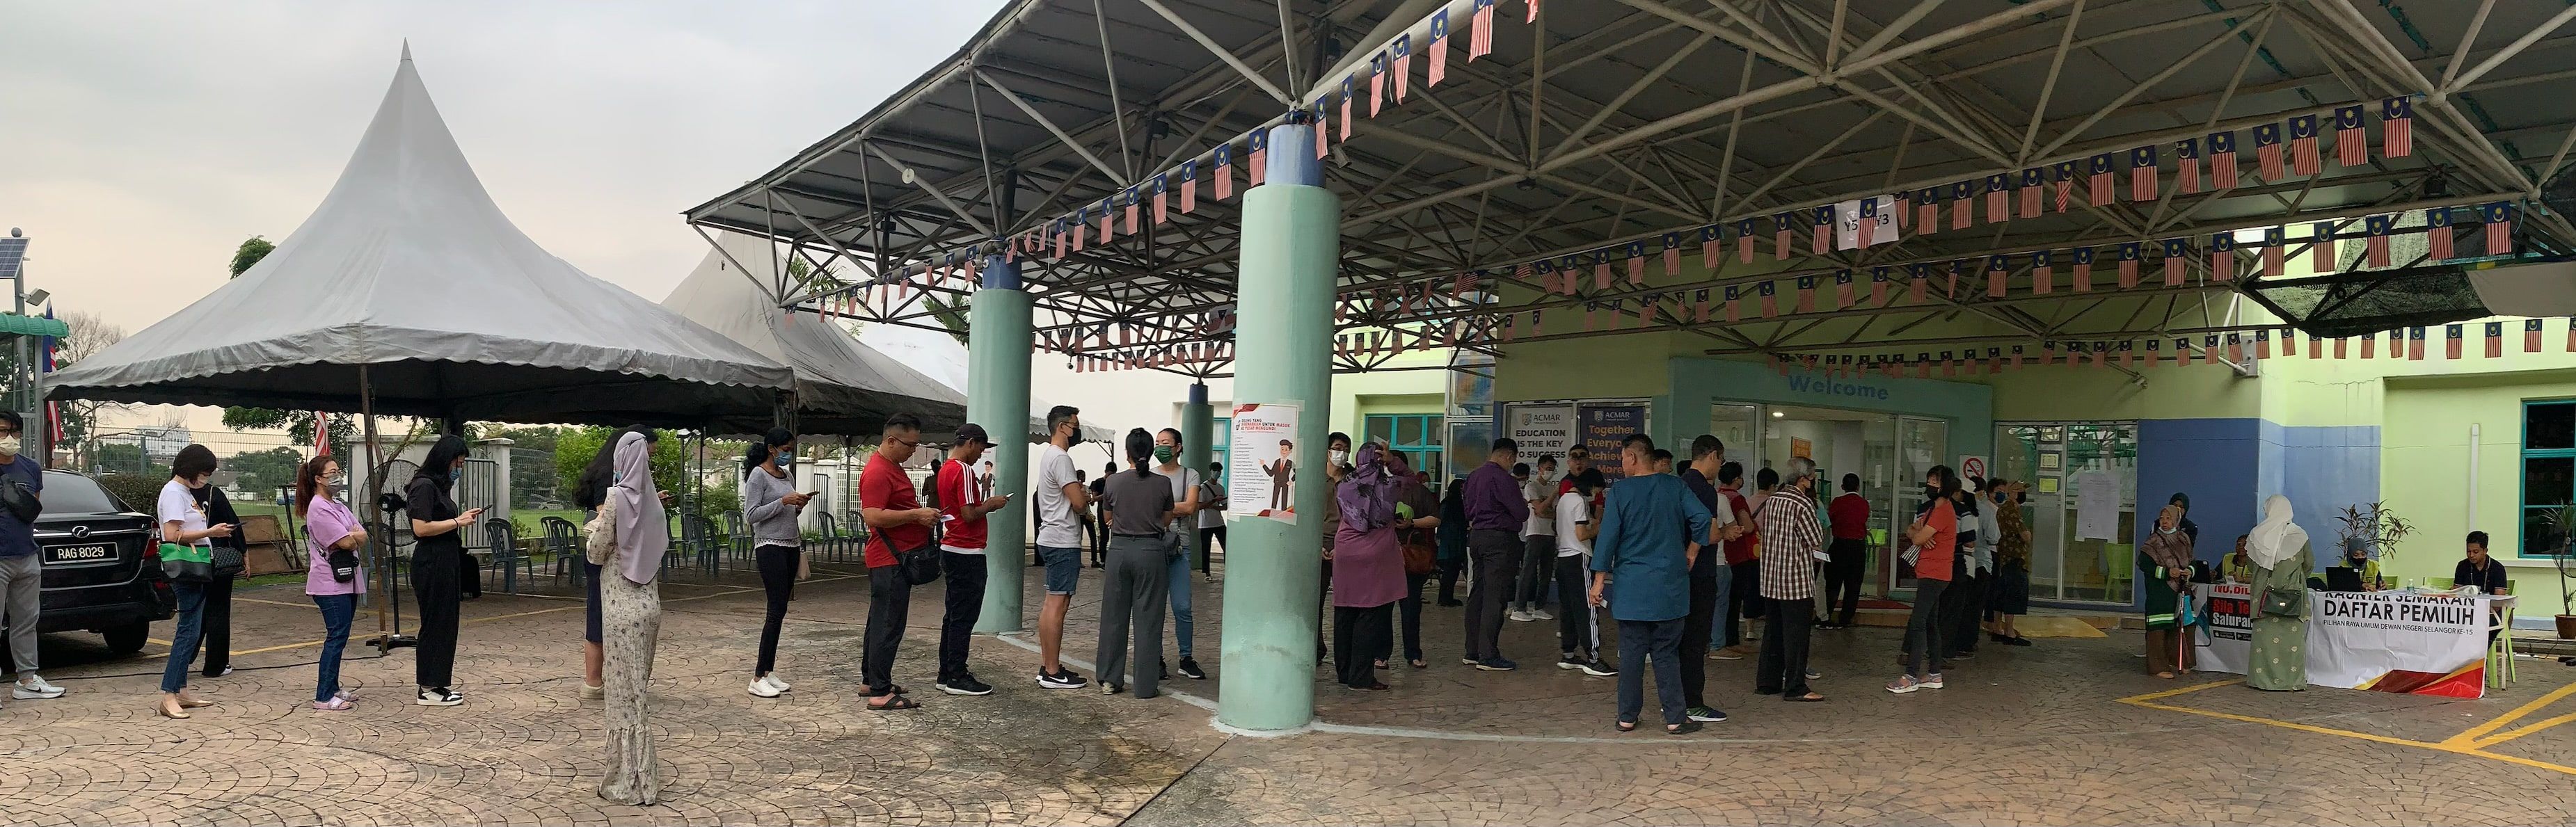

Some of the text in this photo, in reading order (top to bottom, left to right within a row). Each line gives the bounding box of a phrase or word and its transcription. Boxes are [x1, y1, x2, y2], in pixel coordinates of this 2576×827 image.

[1844, 219, 1858, 232] Y5
[1788, 374, 1889, 400] Welcome
[1589, 425, 1635, 437] Together
[1587, 439, 1622, 450] Everyo
[1589, 451, 1622, 460] Achiev
[58, 546, 104, 559] RAG 8029
[2213, 598, 2234, 614] Sila
[2325, 600, 2474, 625] DAFTAR PEMILIH
